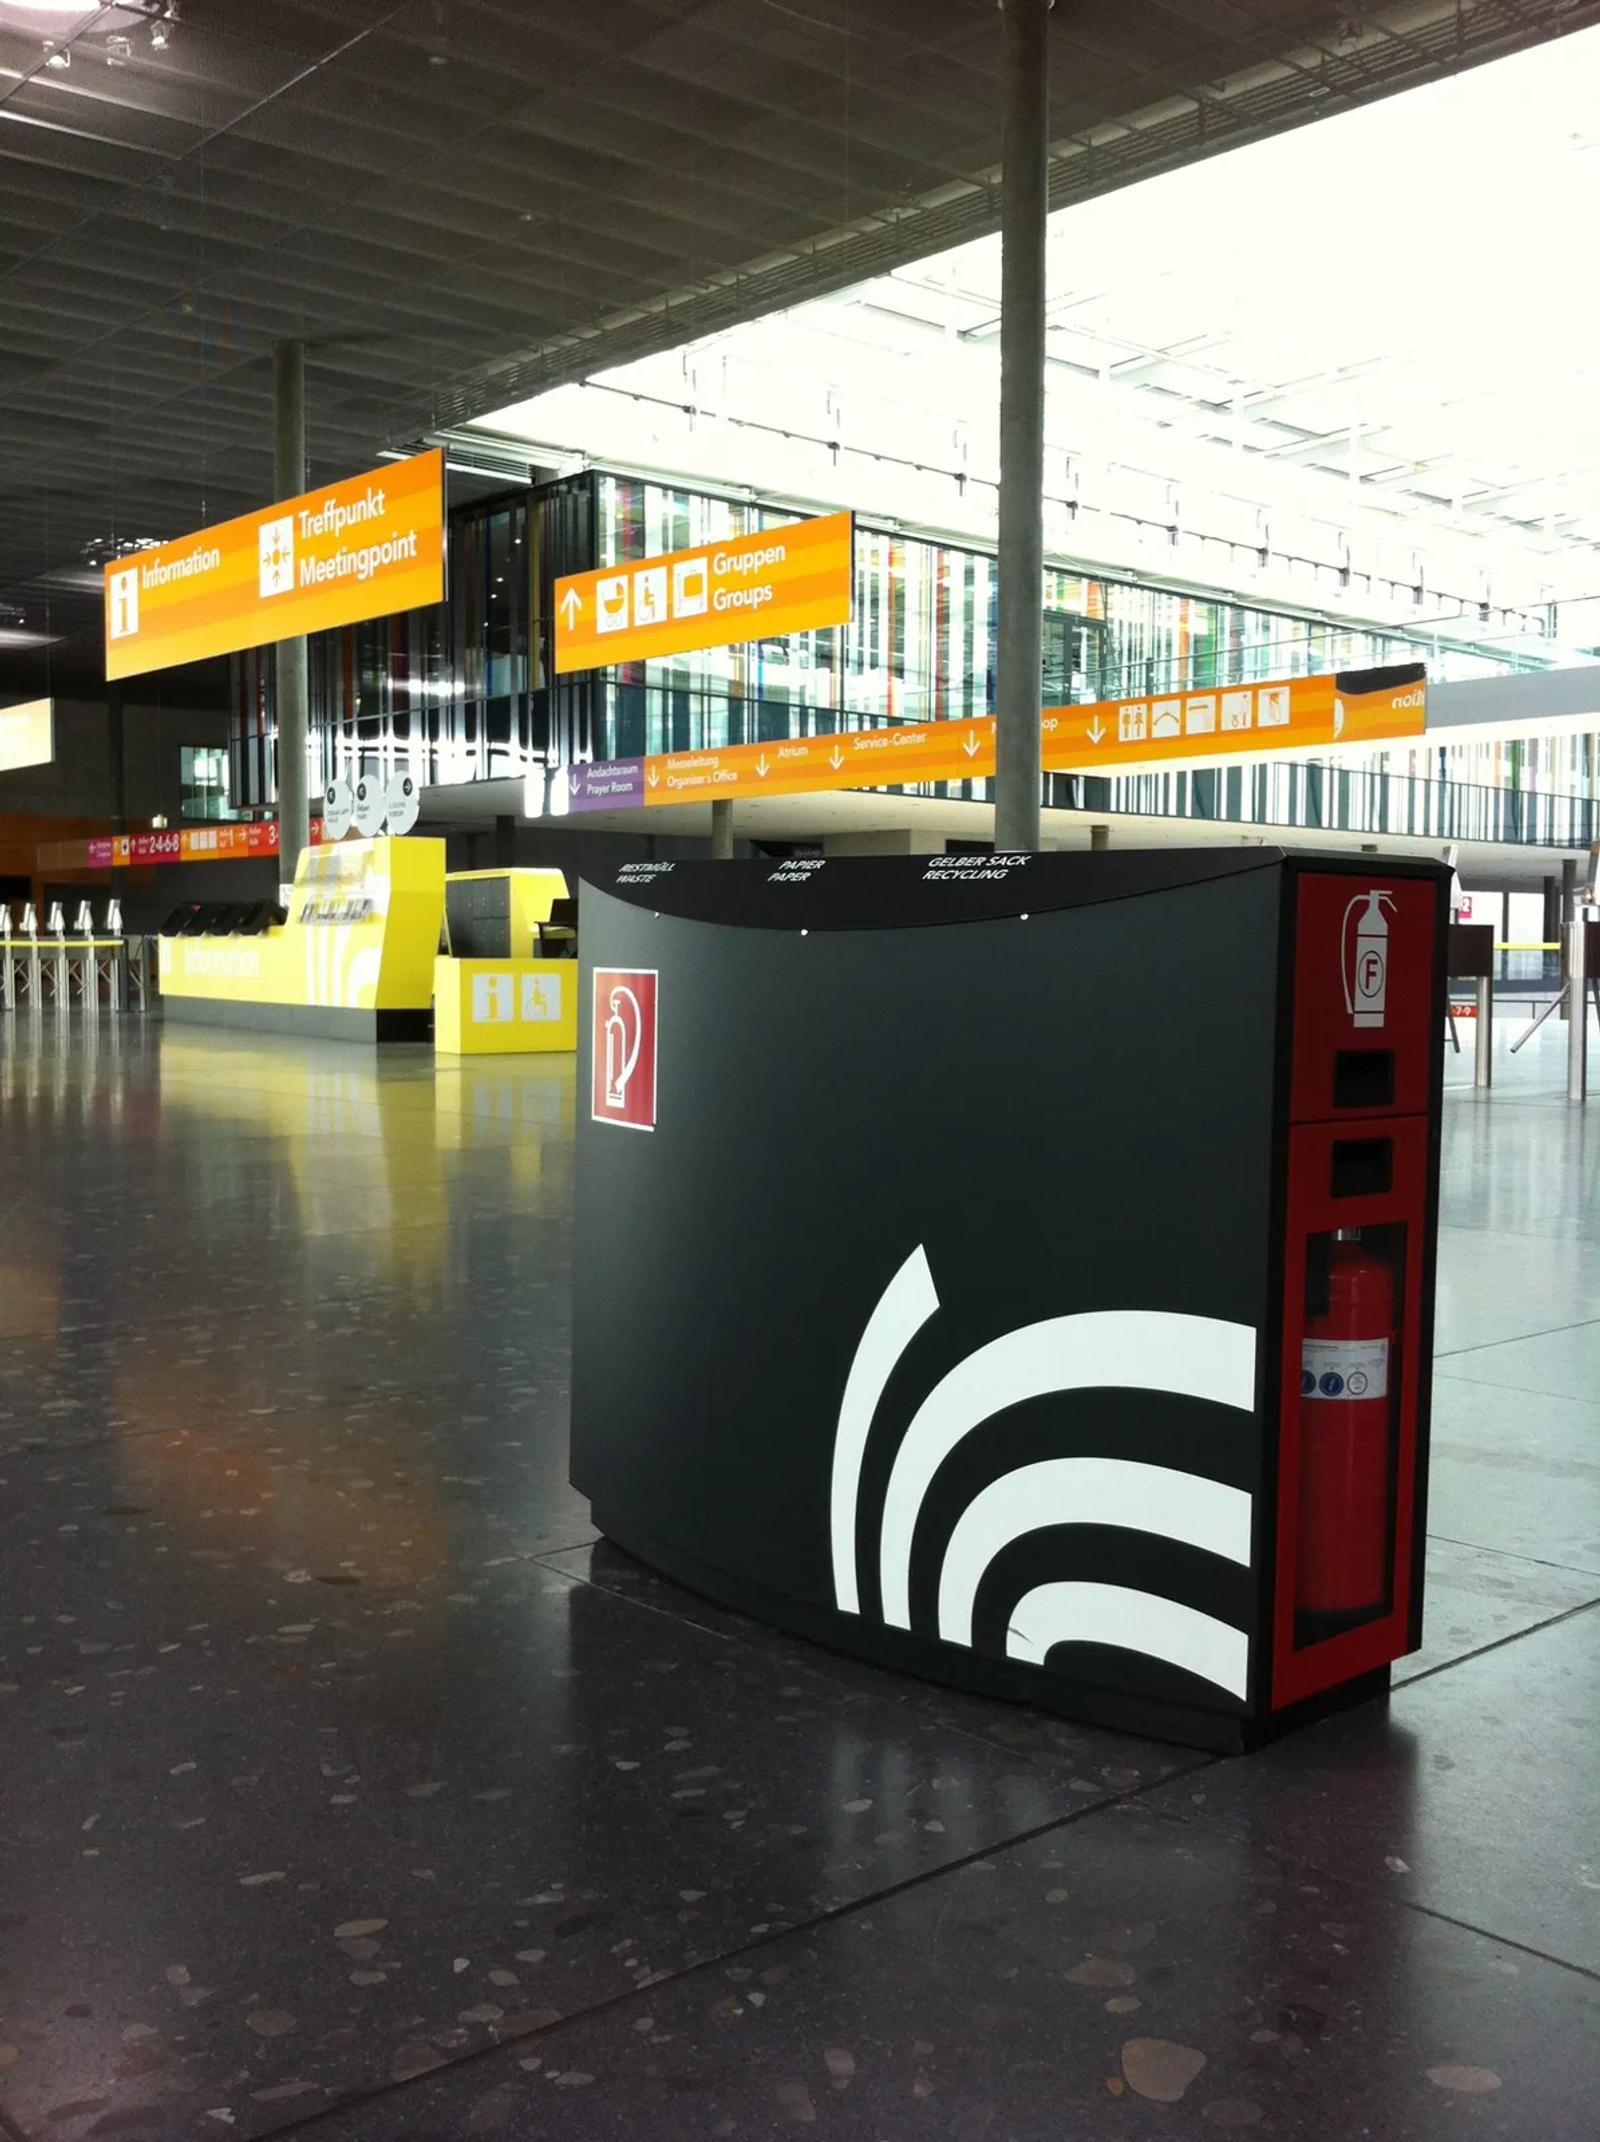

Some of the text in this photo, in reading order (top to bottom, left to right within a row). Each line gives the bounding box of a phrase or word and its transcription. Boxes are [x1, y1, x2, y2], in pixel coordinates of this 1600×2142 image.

[298, 487, 386, 540] Treffpunkt
[299, 529, 418, 588] Meetingpoint
[712, 544, 786, 576] Gruppen
[142, 546, 221, 590] Information
[712, 583, 773, 611] Groups
[853, 731, 927, 751] Service-Center
[777, 746, 808, 759] Atrium
[611, 781, 633, 793] Room
[618, 861, 676, 873] RESTMÜLL
[778, 860, 826, 870] PAPIER
[928, 855, 1032, 868] GELBER SACK
[615, 874, 657, 884] WASTE
[767, 872, 812, 882] PAPER
[922, 869, 1009, 881] RECYCLING
[1365, 958, 1379, 990] F
